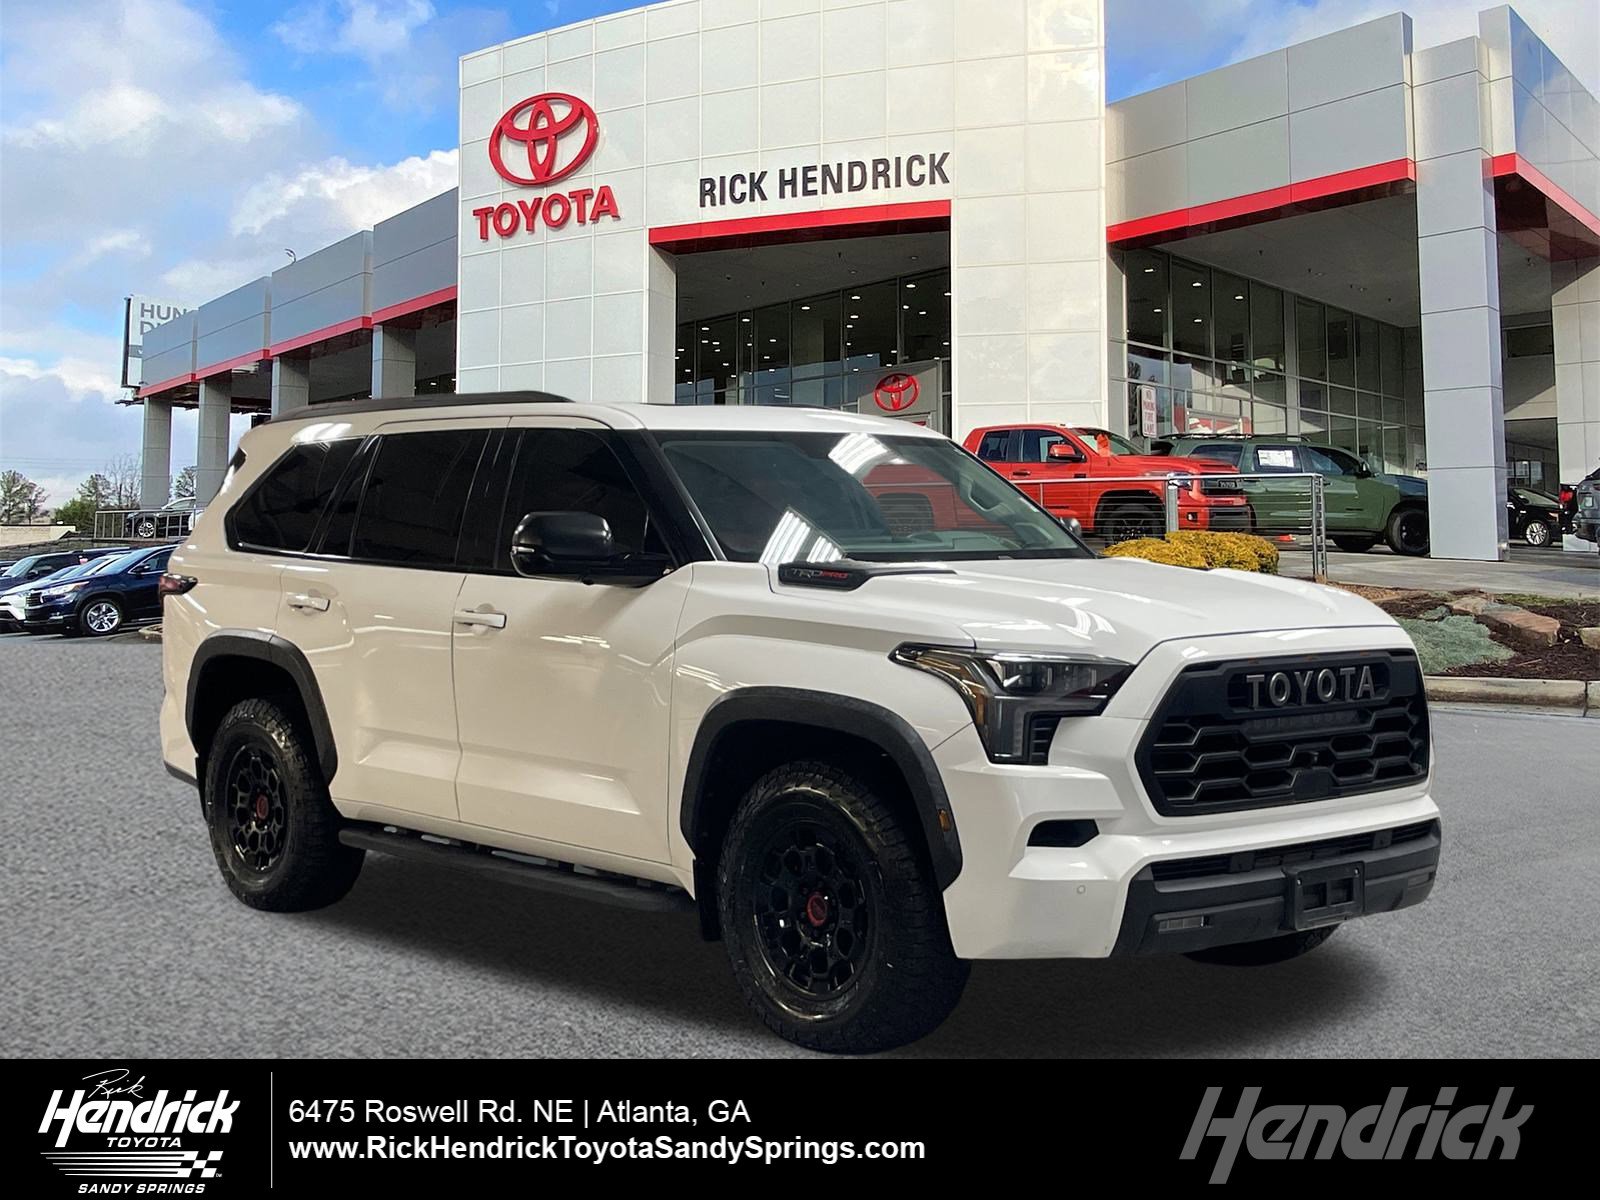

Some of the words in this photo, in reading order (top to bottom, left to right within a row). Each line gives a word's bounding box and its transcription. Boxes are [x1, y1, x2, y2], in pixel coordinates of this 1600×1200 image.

[699, 170, 767, 208] RICK
[778, 151, 951, 199] HENDRICK
[472, 185, 621, 241] TOYOTA
[1246, 665, 1376, 711] TOYOTA
